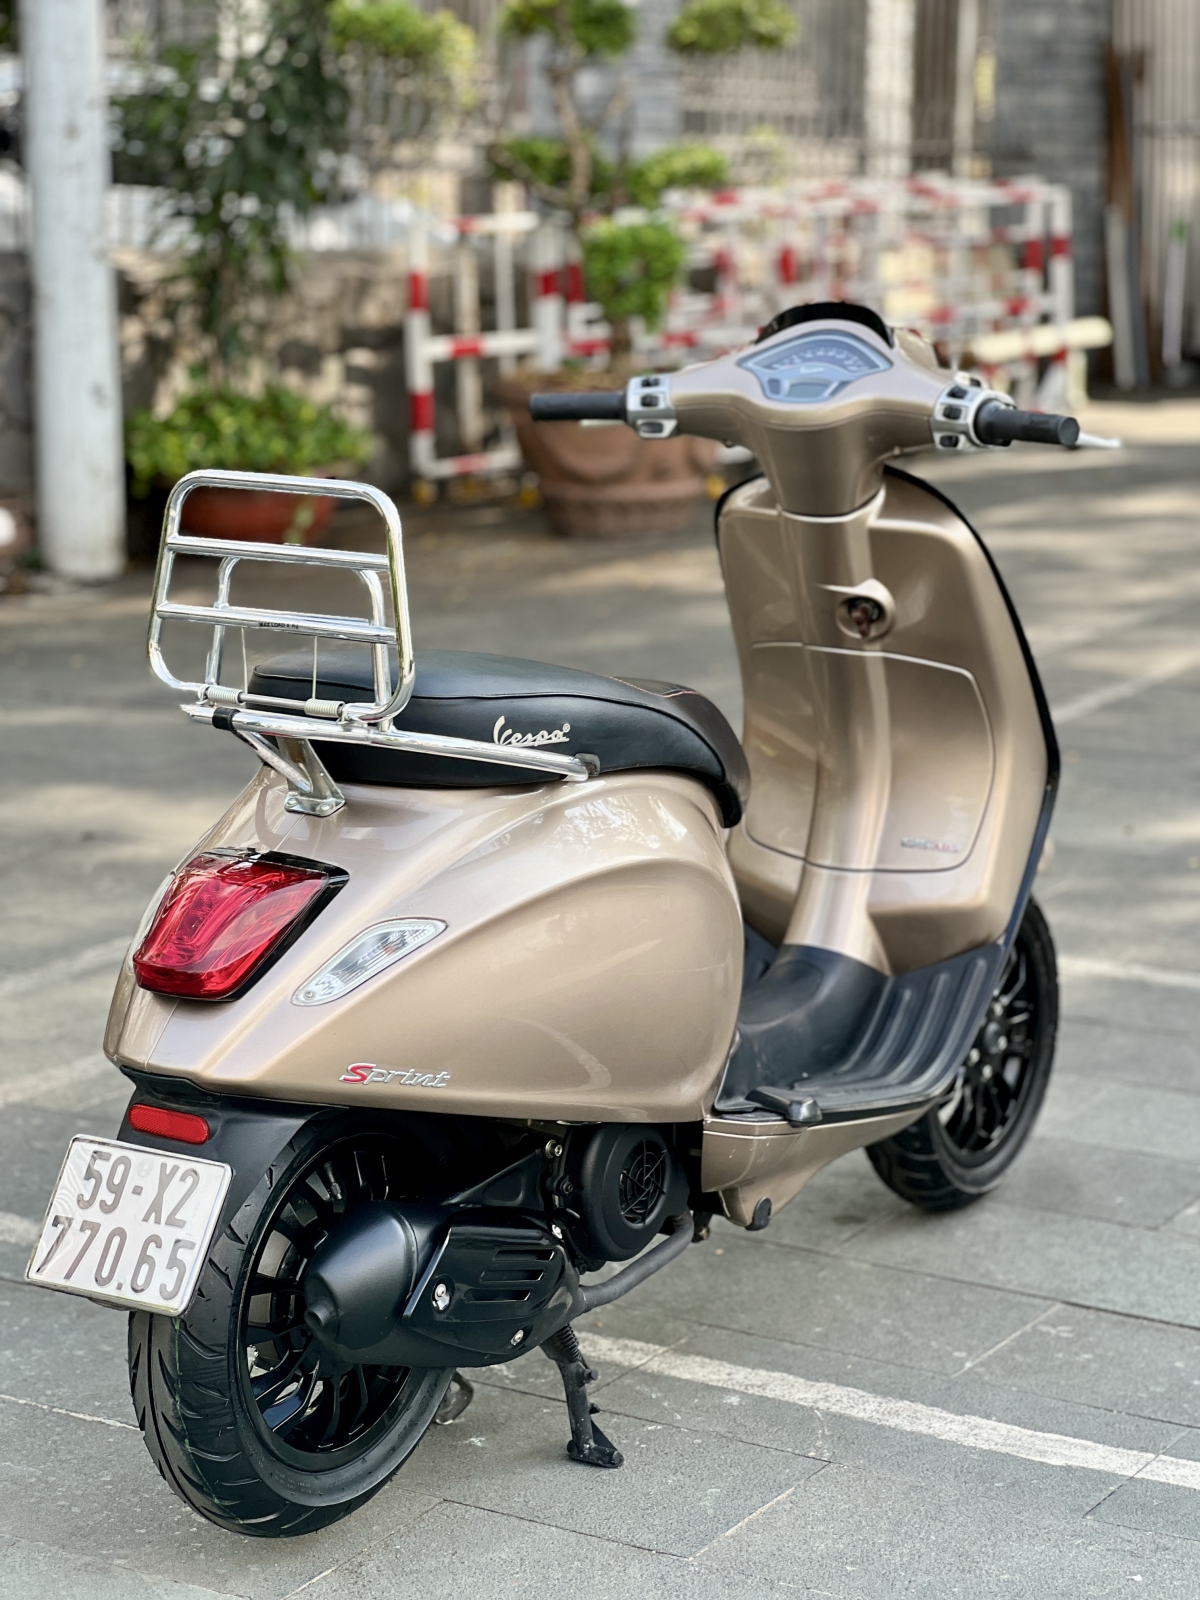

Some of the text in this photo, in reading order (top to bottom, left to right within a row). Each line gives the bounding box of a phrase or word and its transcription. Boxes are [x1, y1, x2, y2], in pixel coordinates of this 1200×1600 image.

[339, 1062, 451, 1088] Sprint
[76, 1150, 200, 1229] 59-X2
[36, 1214, 197, 1301] 770.65
